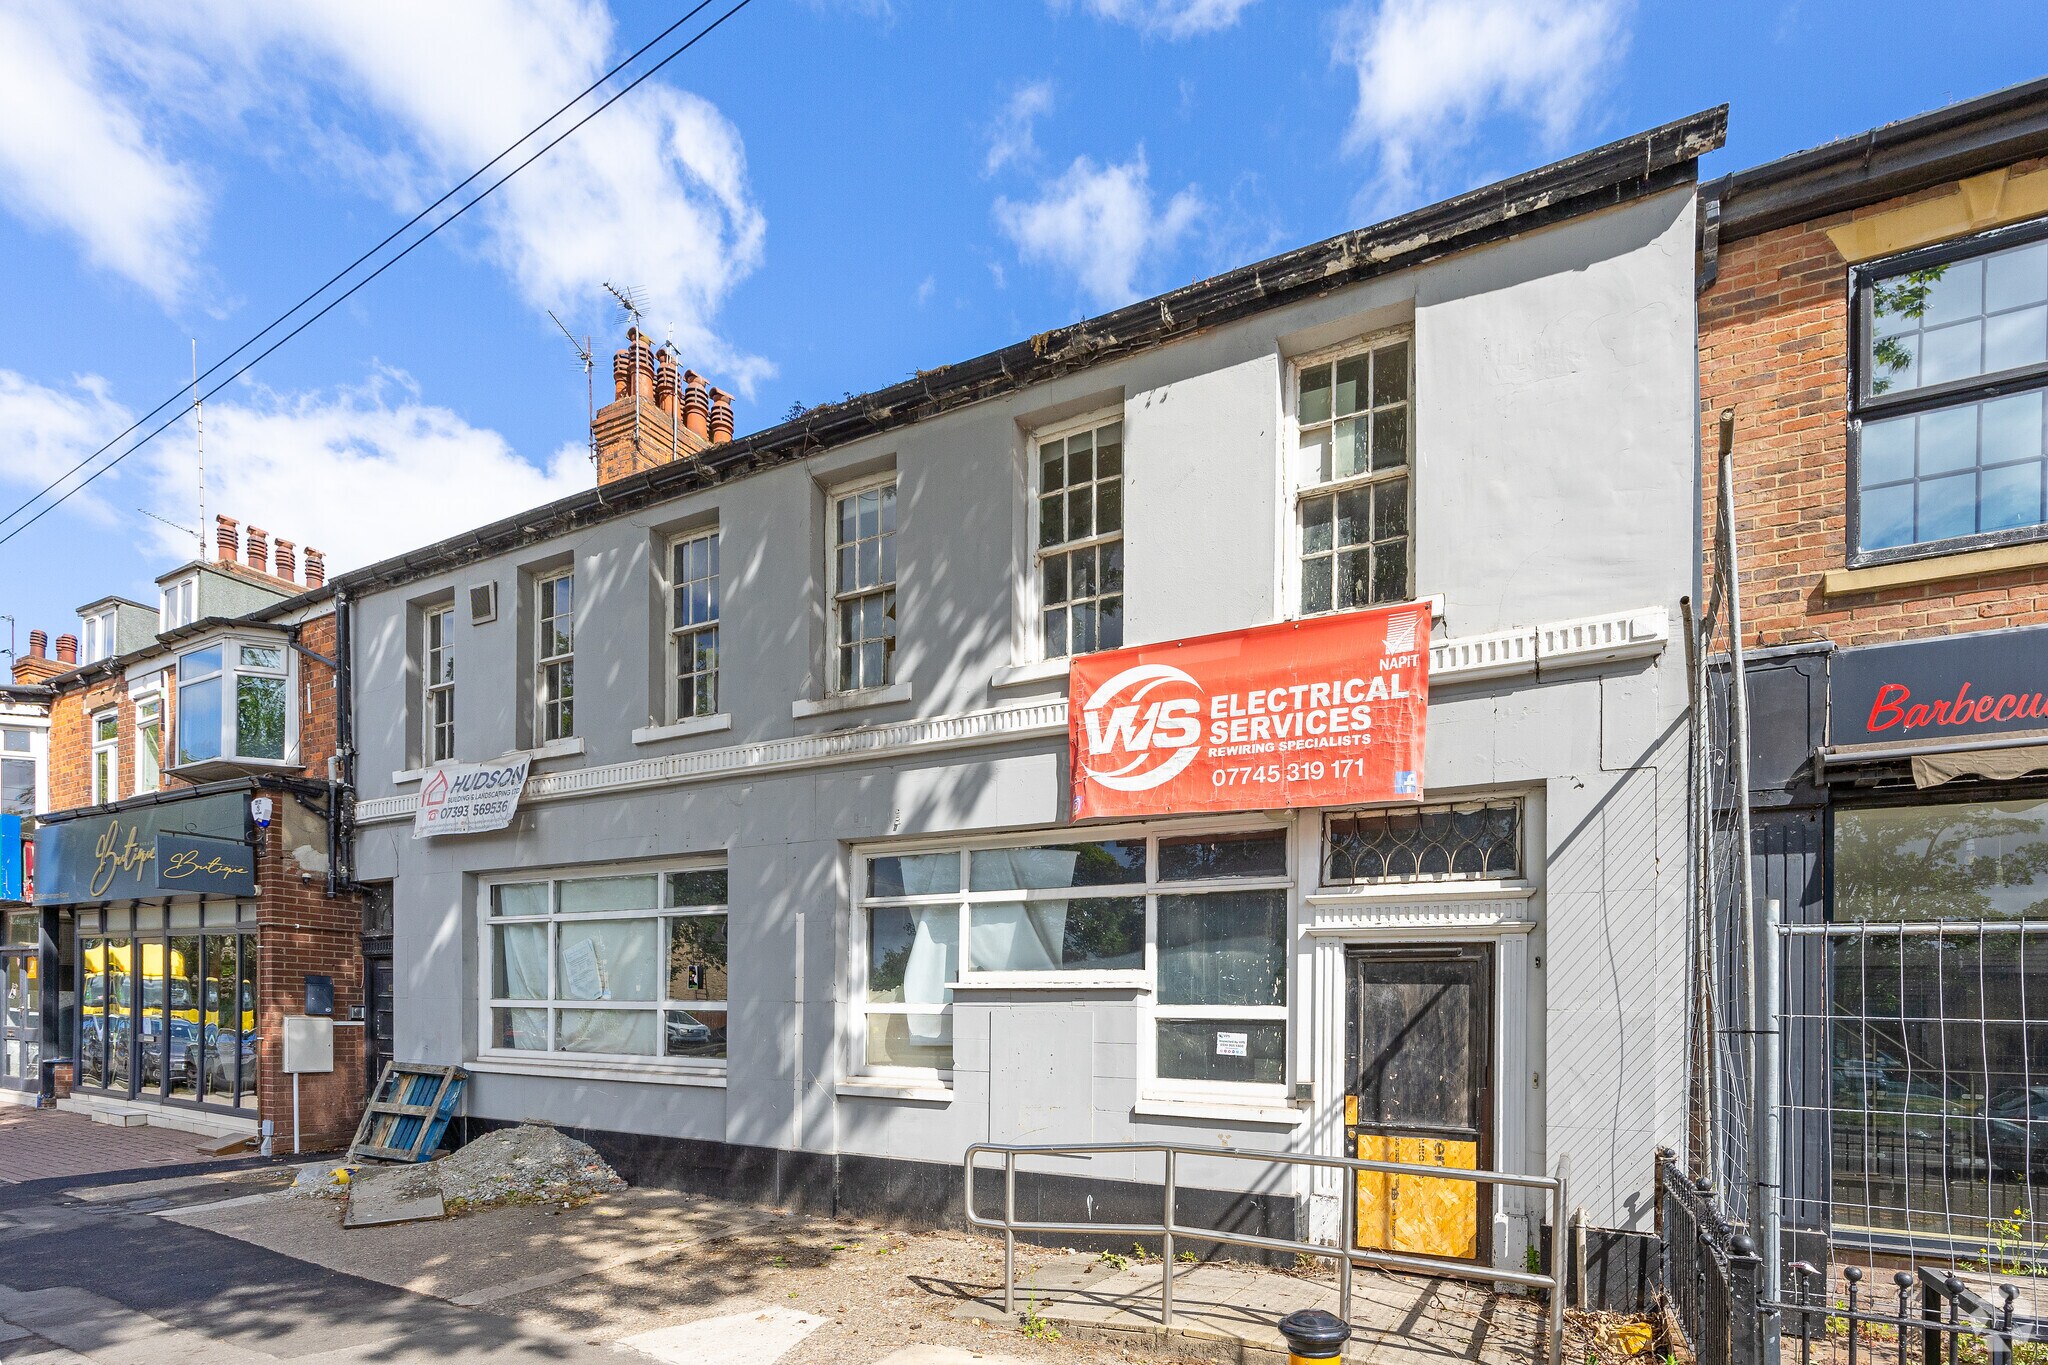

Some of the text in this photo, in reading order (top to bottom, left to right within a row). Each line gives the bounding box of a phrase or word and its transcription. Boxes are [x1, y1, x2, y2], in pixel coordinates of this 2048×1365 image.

[1379, 654, 1420, 671] NAPIT
[1210, 673, 1410, 720] ELECTRICAL
[1209, 704, 1372, 745] SERVICES
[1208, 732, 1371, 758] REWIRING SPECIALISTS
[450, 763, 526, 794] HUDSON
[1212, 757, 1365, 787] 07745 319 171
[447, 795, 470, 804] BUILDING
[475, 789, 511, 801] LANDSCAPING
[511, 787, 520, 796] LTD
[440, 800, 509, 820] 07393 569536
